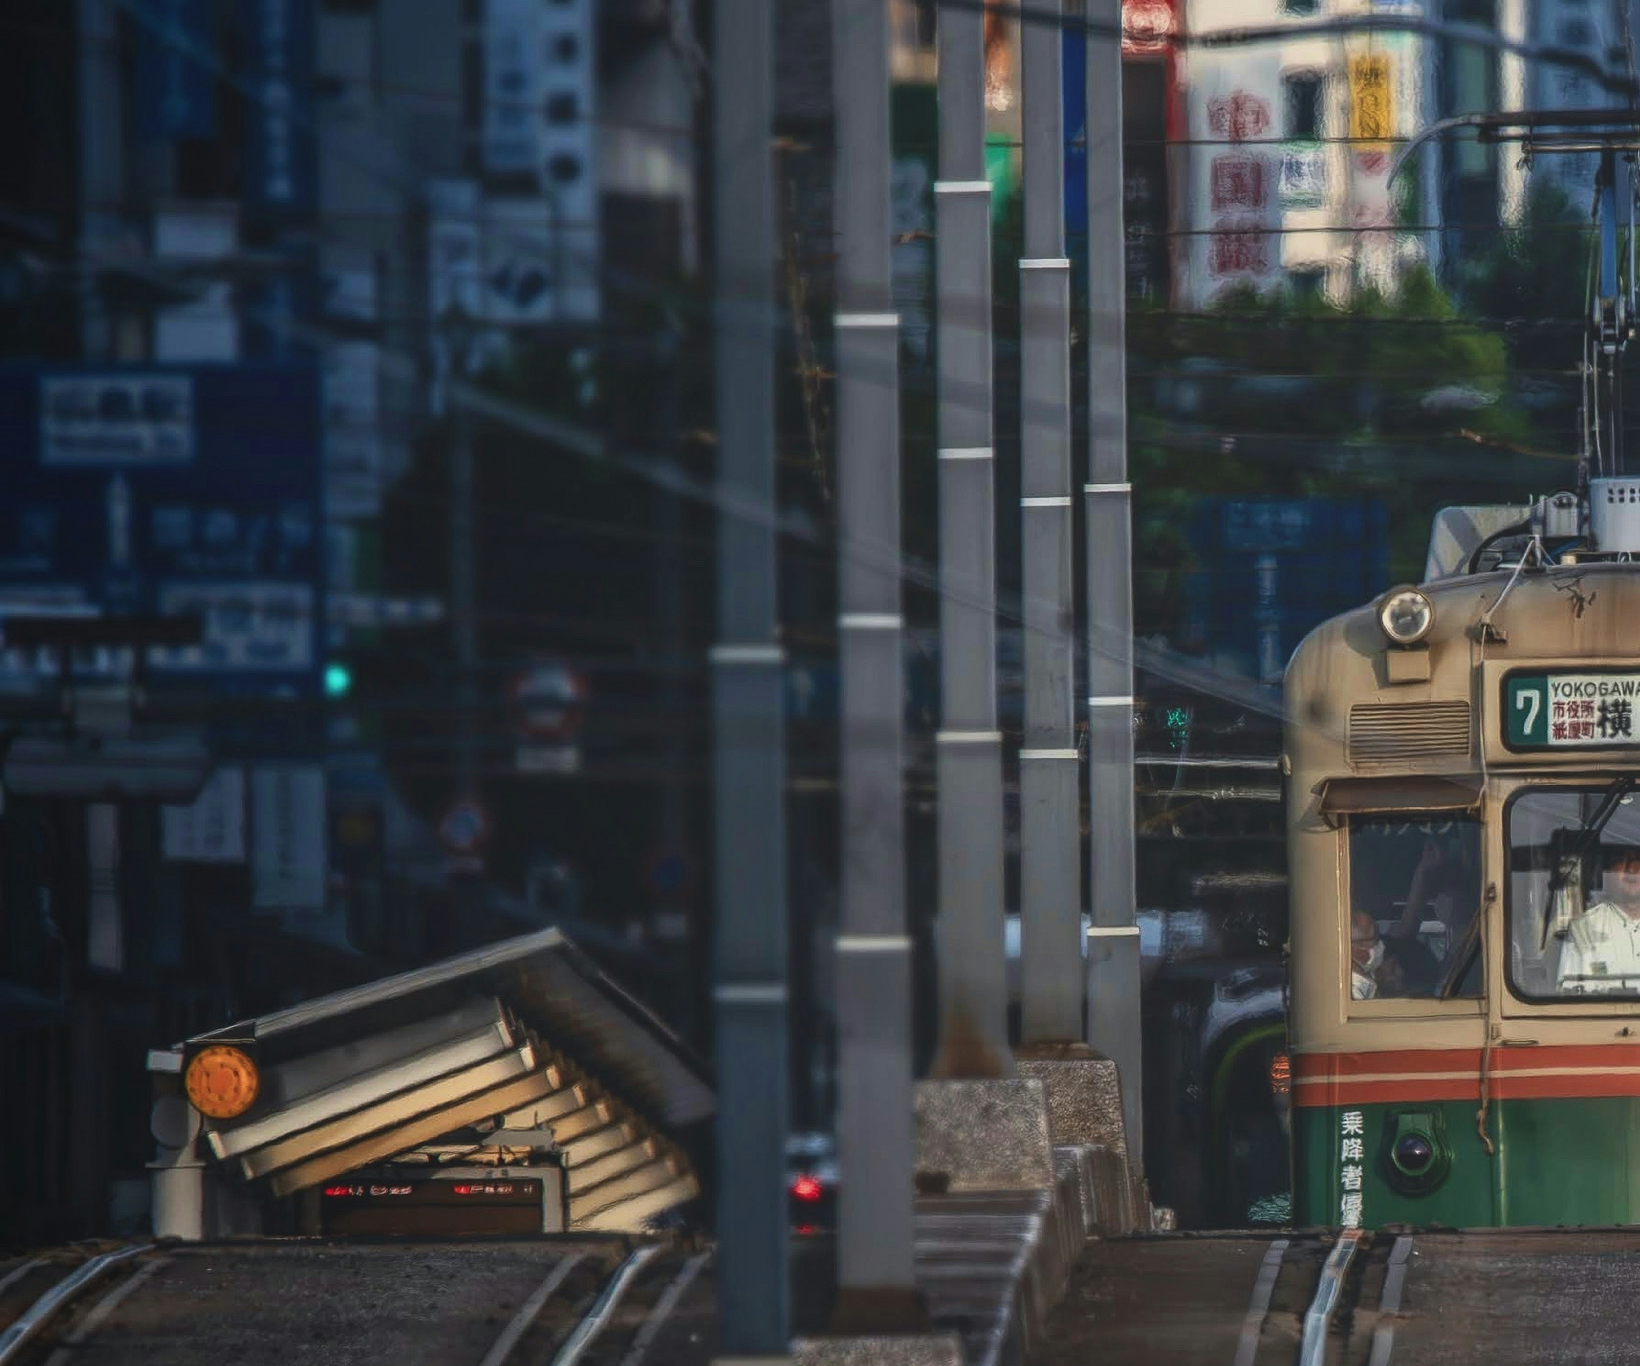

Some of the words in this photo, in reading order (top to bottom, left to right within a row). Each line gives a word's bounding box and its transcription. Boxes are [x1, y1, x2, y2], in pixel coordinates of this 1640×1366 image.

[1516, 689, 1540, 735] 7
[1552, 700, 1595, 719] 市役所
